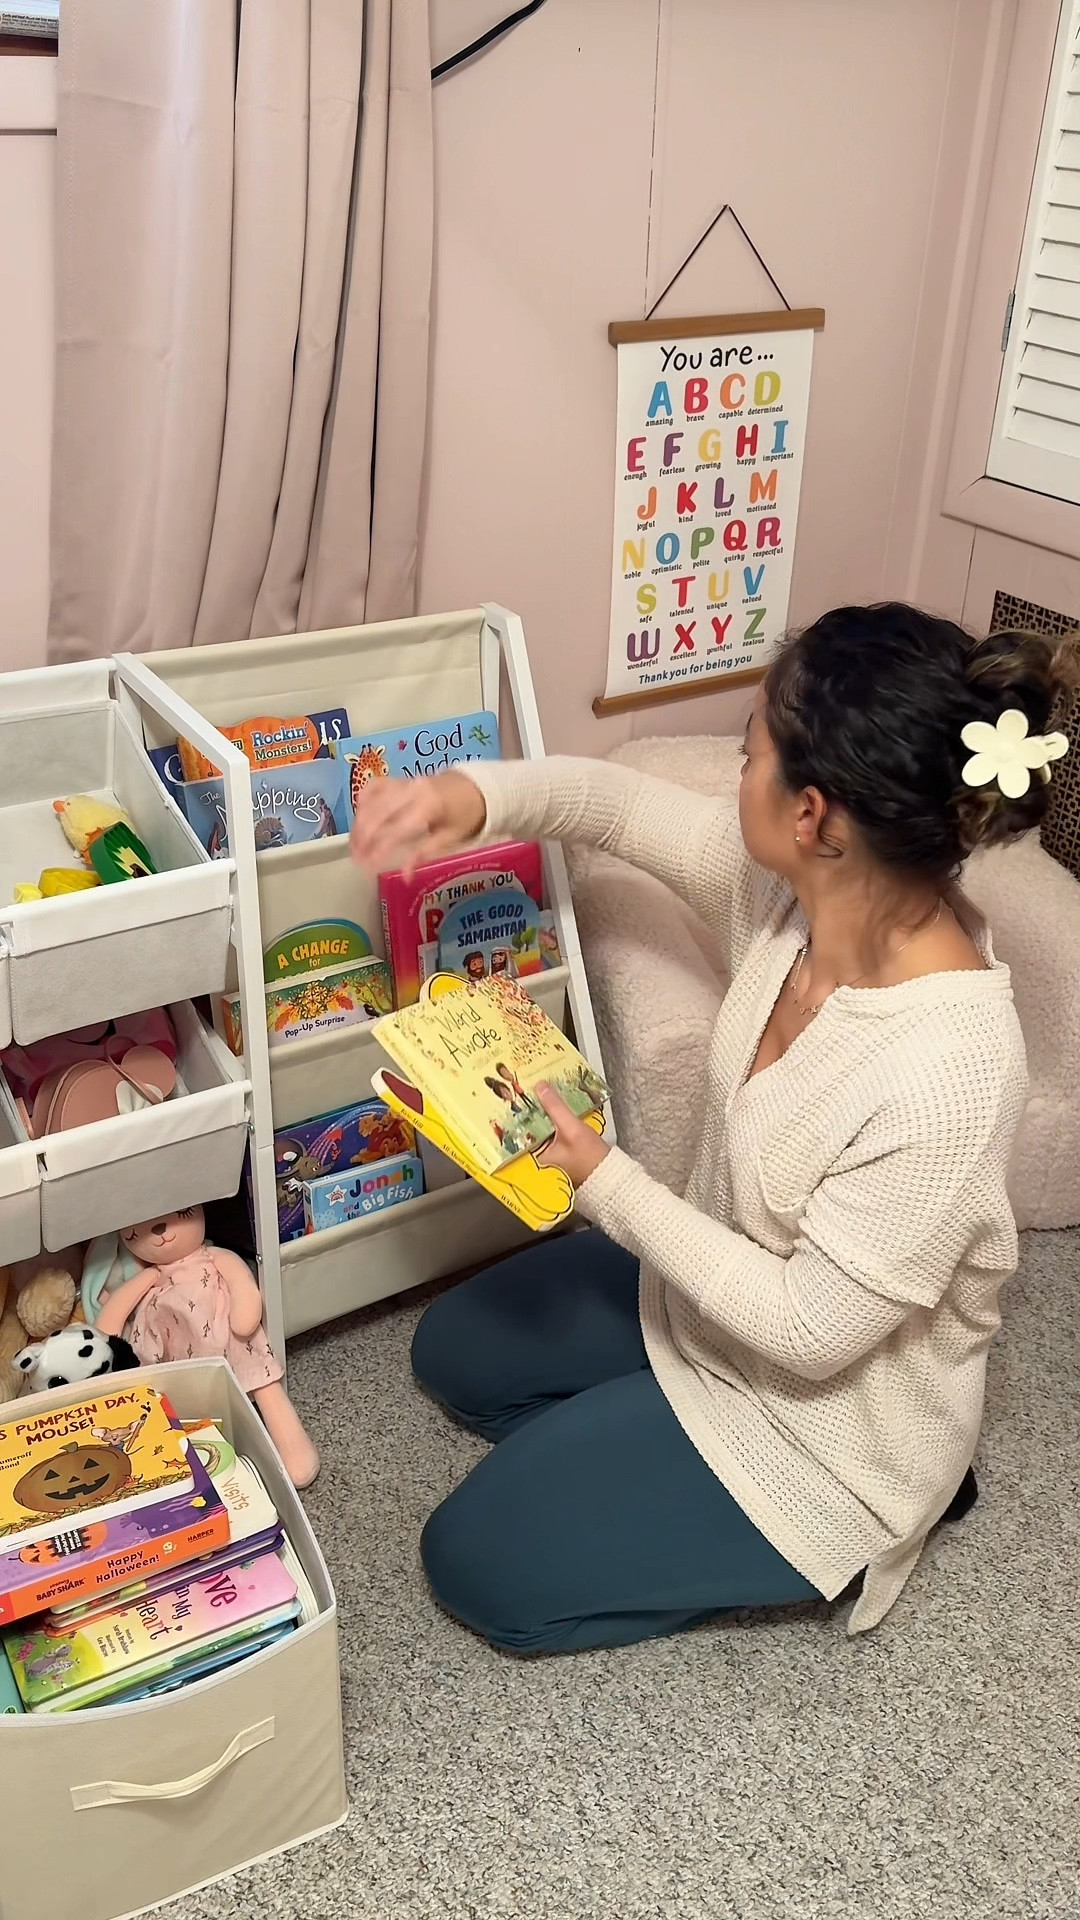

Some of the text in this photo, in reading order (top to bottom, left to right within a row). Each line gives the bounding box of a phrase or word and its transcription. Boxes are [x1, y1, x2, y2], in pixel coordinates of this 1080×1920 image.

[660, 345, 702, 372] You
[647, 371, 781, 418] A B C D
[645, 405, 784, 427] amazing brave capable determined
[627, 420, 789, 472] E F G H I
[623, 452, 794, 481] enough fearless growing happy important
[636, 469, 778, 520] J K L M
[637, 503, 777, 532] joyful kind loved motivated
[622, 516, 782, 572] N O P Q R
[624, 547, 784, 580] noble optimistic polite quirky respectful
[636, 564, 766, 615] S T U V
[639, 595, 762, 624] safe talented unique valued
[626, 607, 767, 662] W X Y Z
[627, 638, 765, 670] wonderful excellent youthful zealous
[638, 654, 752, 685] Thank you for being you
[252, 721, 309, 747] Rockin'
[414, 722, 464, 757] God
[255, 740, 313, 761] Monsters!
[200, 791, 221, 805] The
[424, 890, 443, 905] MY
[447, 880, 486, 900] THANK
[489, 871, 514, 887] YOU
[459, 910, 485, 931] THE
[488, 904, 524, 920] GOOD
[457, 919, 527, 948] SAMARITAN
[277, 939, 350, 970] A CHANGE
[309, 958, 321, 968] for
[284, 1022, 314, 1039] Pop-Up
[314, 1015, 346, 1029] Surprise
[434, 1002, 482, 1033] World
[438, 1026, 502, 1067] Awake
[361, 1185, 414, 1211] Big Fish
[15, 1404, 98, 1436] PUMPKIN
[25, 1417, 96, 1446] MOUSE!
[187, 1528, 214, 1541] HARPER
[96, 1555, 160, 1584] Halloween!
[107, 1550, 144, 1569] Happy
[36, 1578, 86, 1602] BABY SHARK
[136, 1600, 173, 1641] Heart
[171, 1598, 193, 1620] My
